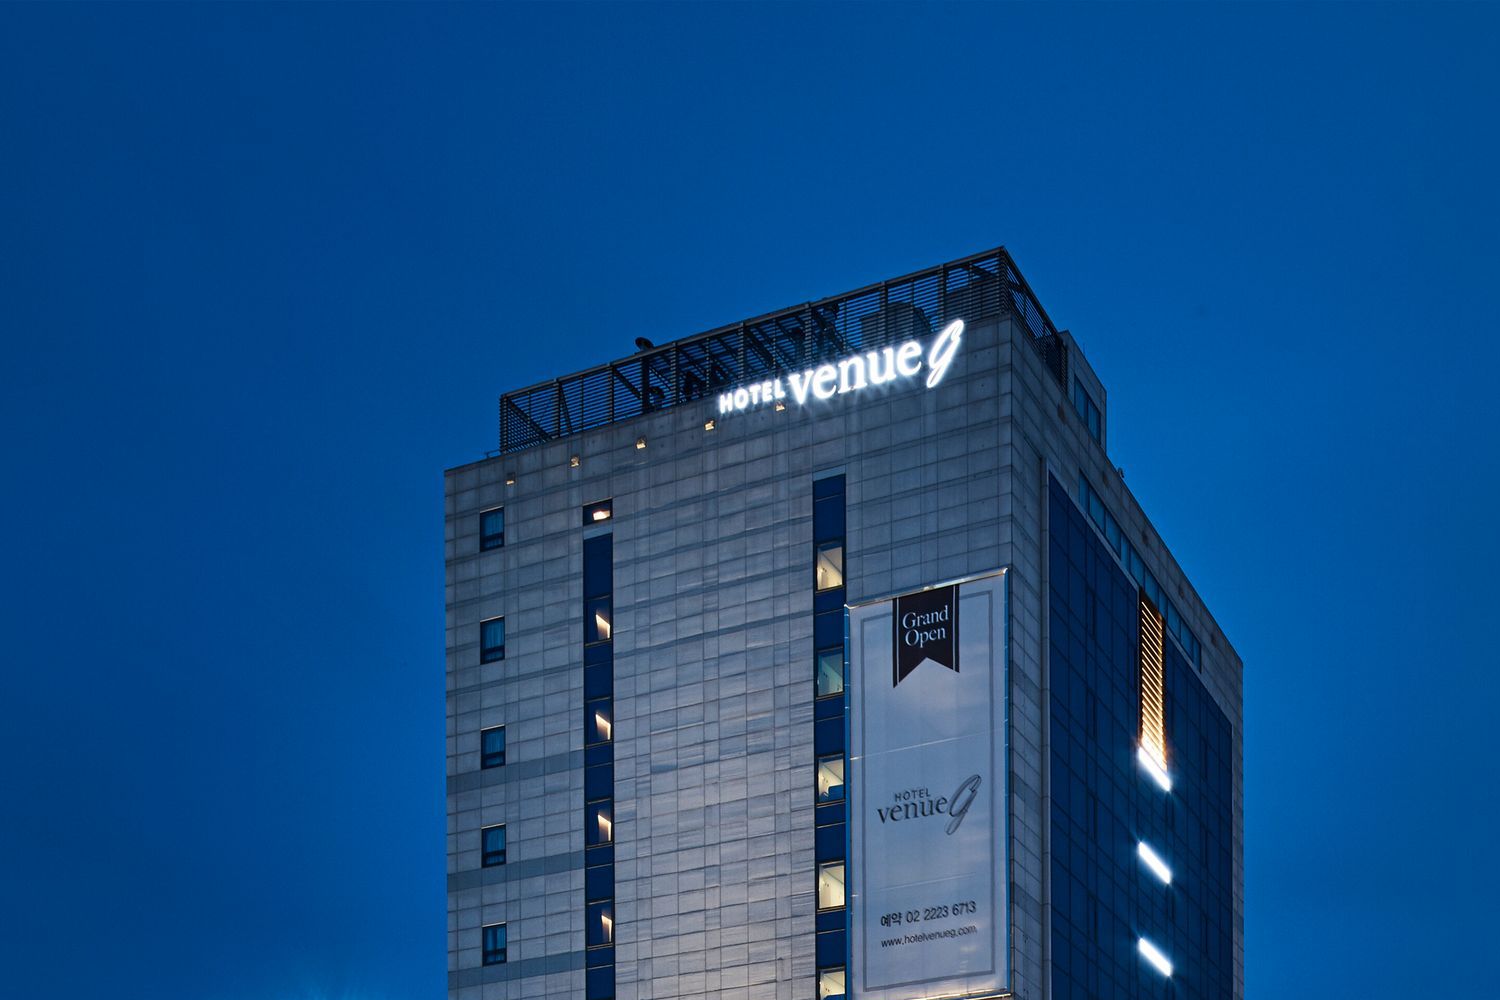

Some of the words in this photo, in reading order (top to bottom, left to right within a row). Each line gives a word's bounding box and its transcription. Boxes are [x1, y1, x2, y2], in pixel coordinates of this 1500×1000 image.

[719, 378, 786, 414] HOTEL
[788, 340, 922, 405] venue
[902, 604, 949, 630] Grand
[905, 627, 946, 649] Open
[894, 787, 931, 802] HOTEL
[876, 796, 948, 824] venue
[880, 911, 902, 928] 예약
[905, 910, 920, 924] 02
[923, 905, 949, 921] 2223
[951, 901, 977, 916] 6713
[880, 925, 978, 948] www.hotelvenueg.com
